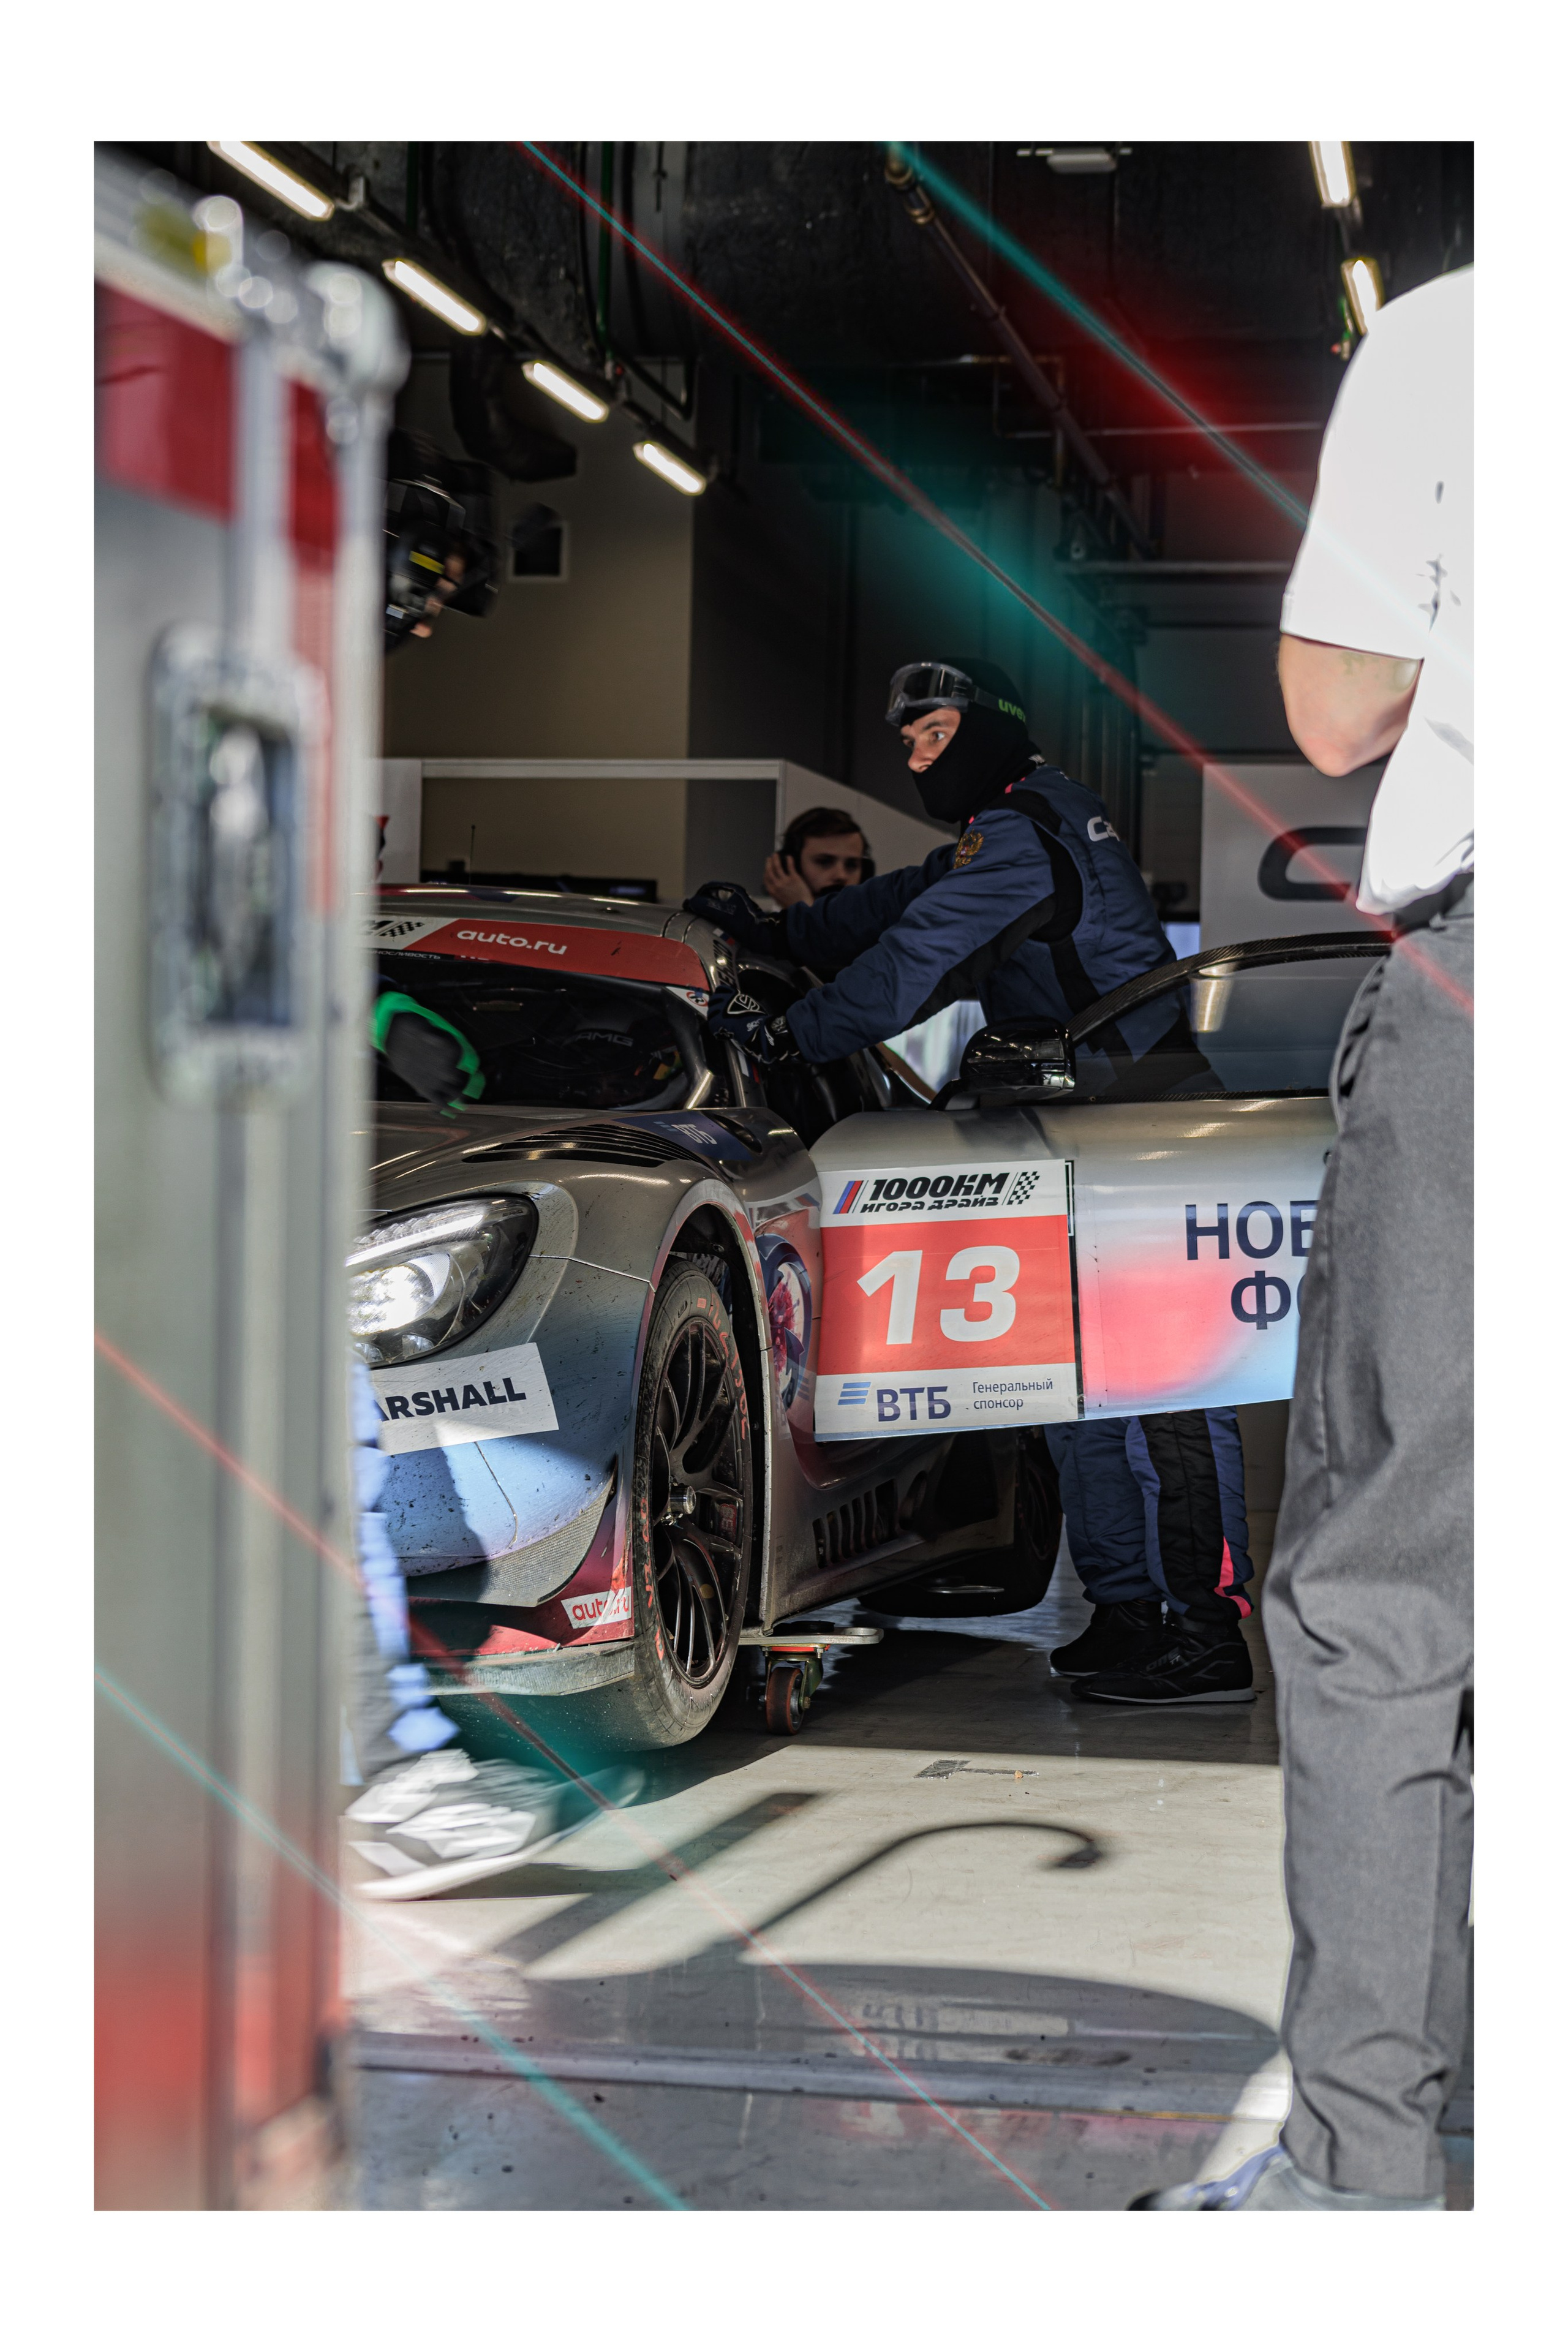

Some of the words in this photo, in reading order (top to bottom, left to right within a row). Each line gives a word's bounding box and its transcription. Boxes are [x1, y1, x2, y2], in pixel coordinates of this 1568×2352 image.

[457, 930, 568, 956] auto.ru
[857, 1245, 1020, 1345] 13
[1231, 1270, 1308, 1330] Ф
[973, 1378, 1053, 1395] Генеральный
[876, 1385, 952, 1422] ВТБ
[973, 1398, 1024, 1411] спонсор
